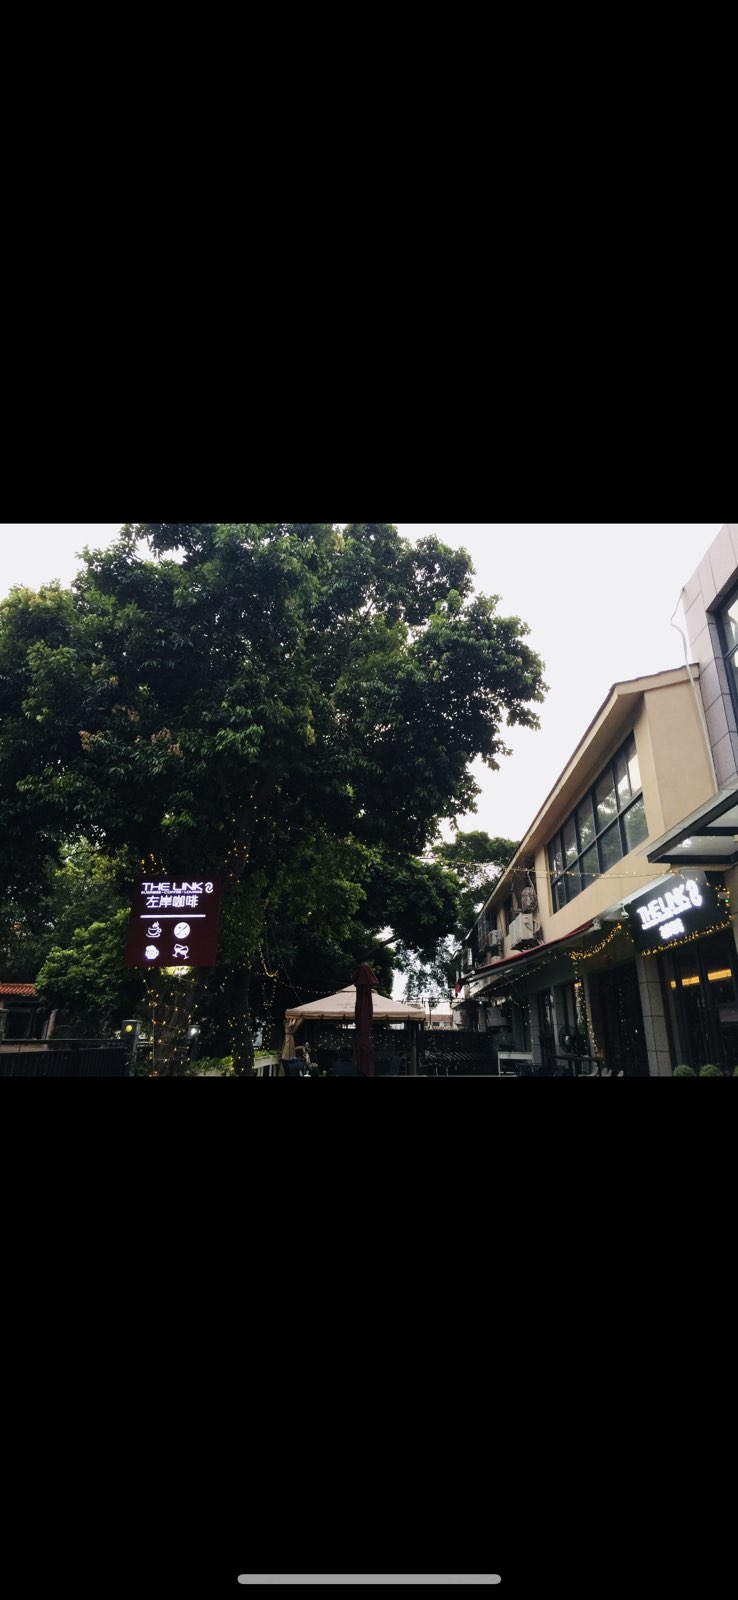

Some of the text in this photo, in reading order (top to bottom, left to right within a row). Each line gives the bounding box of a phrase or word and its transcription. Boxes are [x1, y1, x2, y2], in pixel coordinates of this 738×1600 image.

[142, 881, 204, 891] THE LINK
[146, 895, 199, 908] 左岸咖啡
[637, 899, 660, 923] THE
[657, 884, 690, 914] LINK
